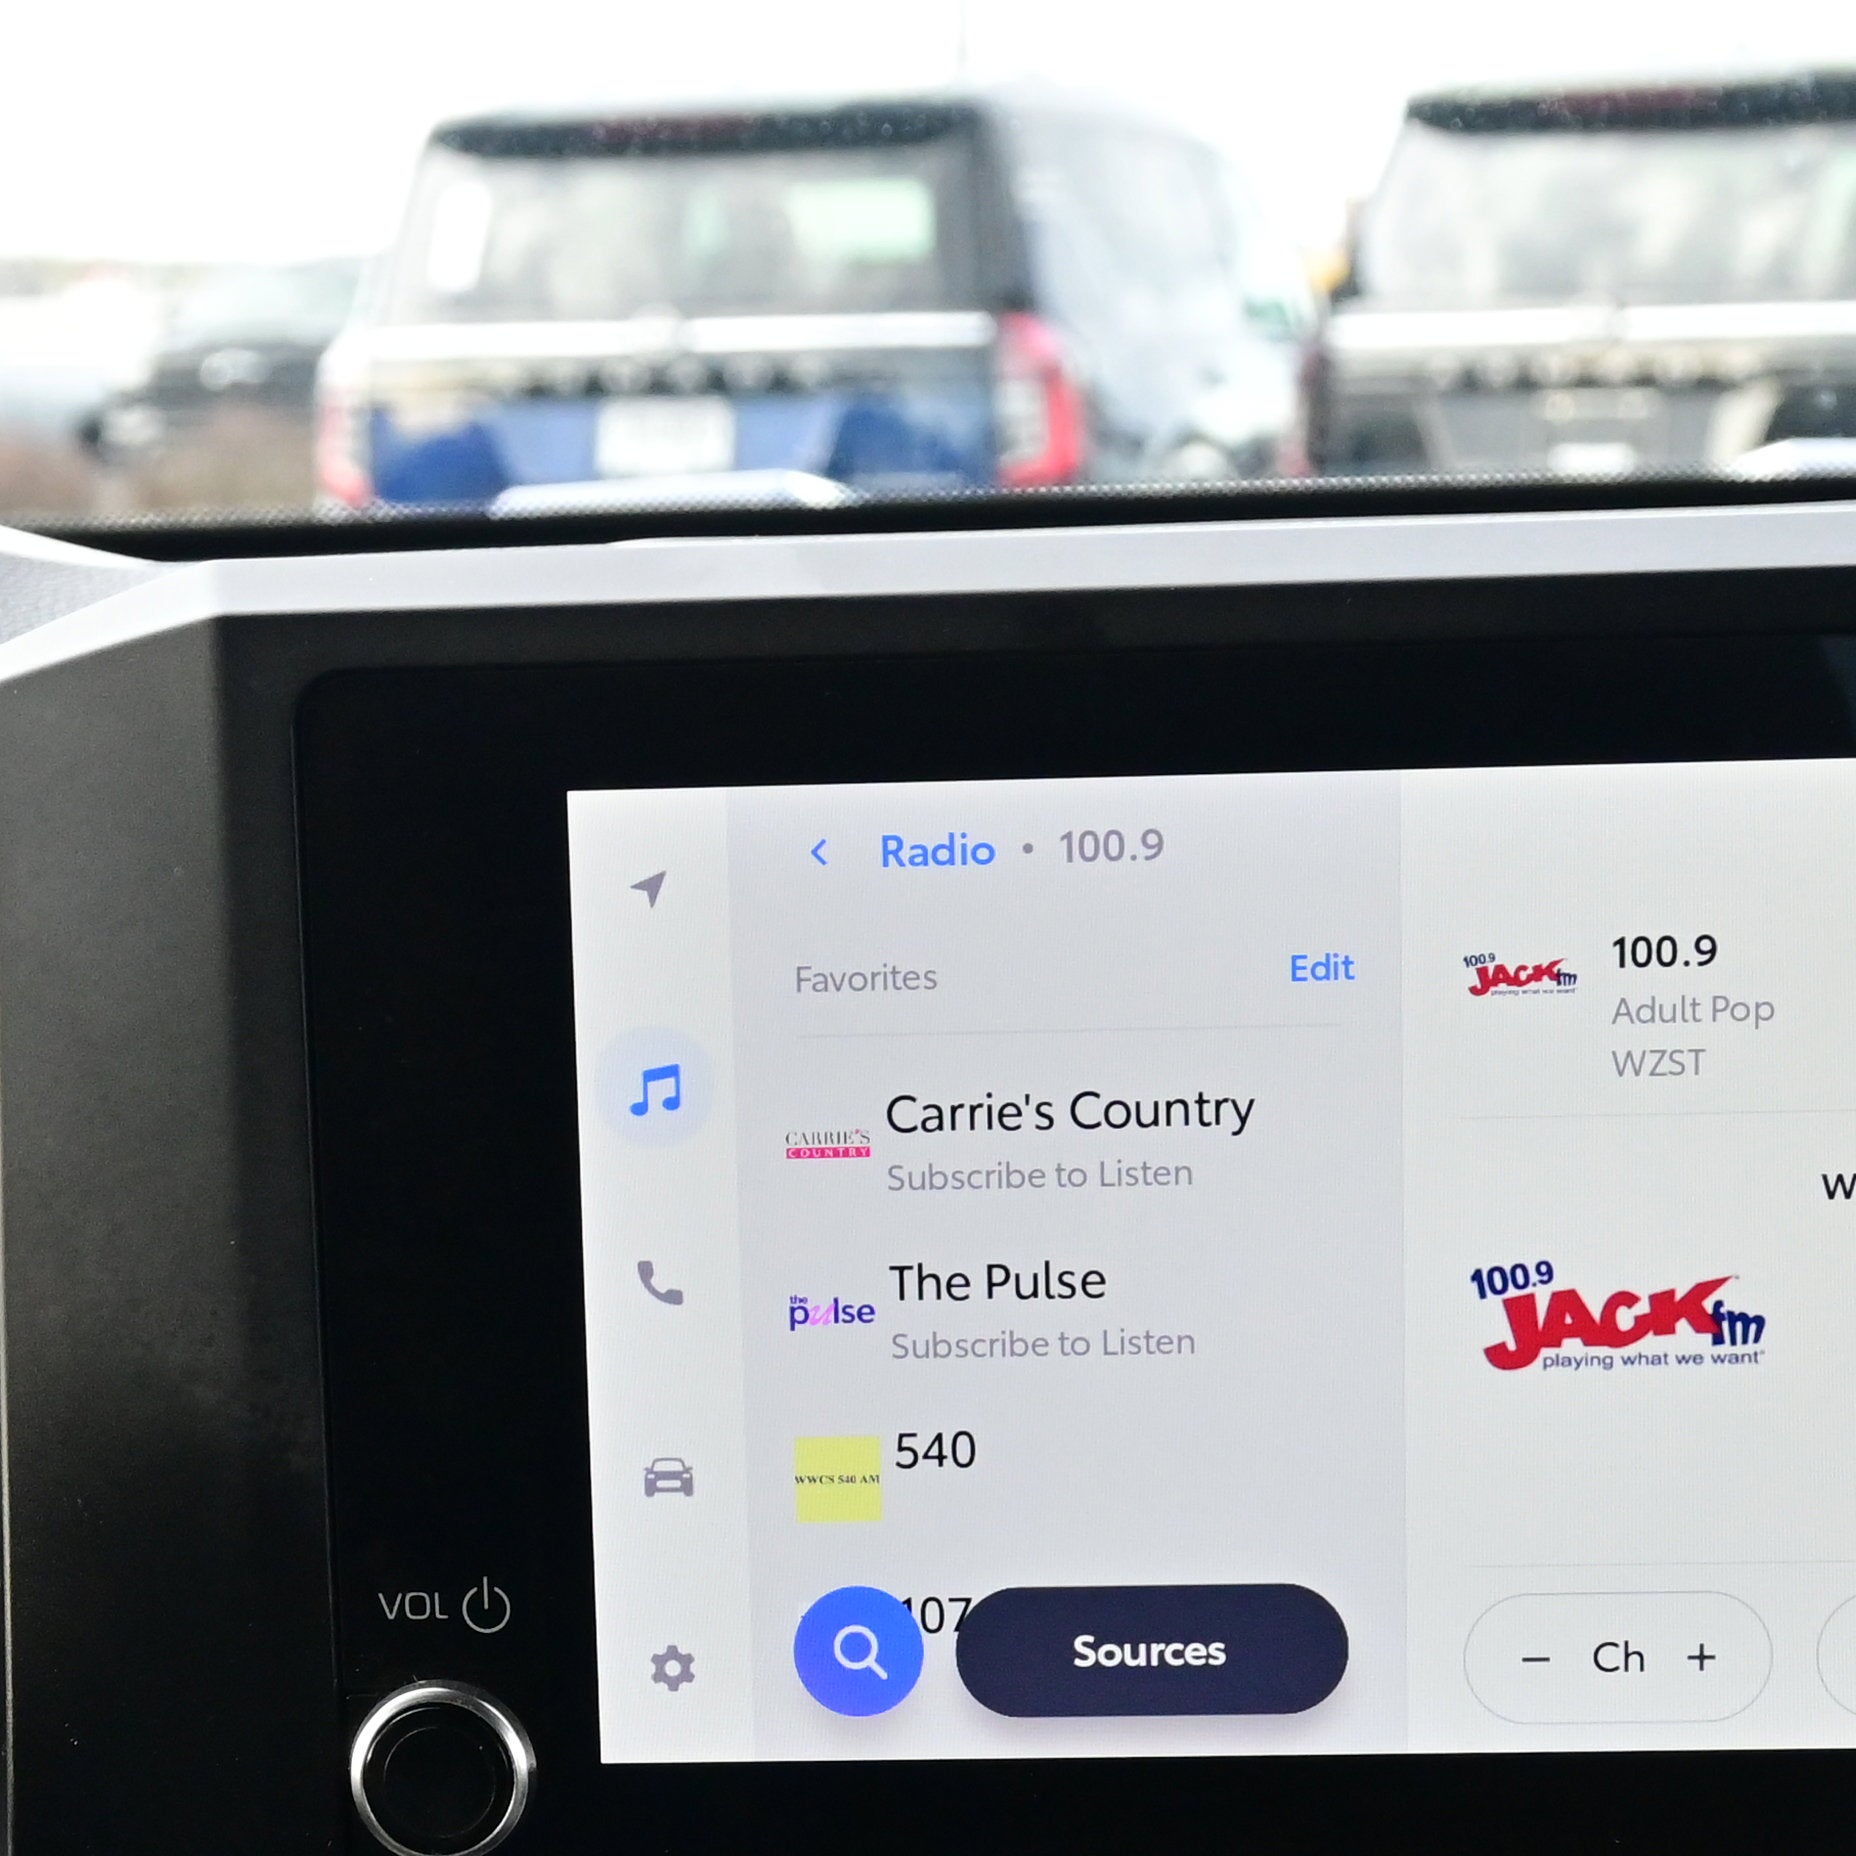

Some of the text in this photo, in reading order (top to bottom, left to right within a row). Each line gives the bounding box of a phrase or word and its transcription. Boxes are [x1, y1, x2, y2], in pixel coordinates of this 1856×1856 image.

[882, 829, 1164, 867] Radio 100.9
[1463, 953, 1496, 968] 100.9
[1613, 934, 1717, 968] 100.9
[796, 963, 937, 993] Favorites
[1291, 953, 1355, 982] Edit
[1468, 958, 1566, 996] JACK
[1612, 995, 1775, 1030] Adult Pop
[1612, 1049, 1706, 1077] WZST
[887, 1091, 1255, 1136] Carrie's Country
[788, 1148, 869, 1158] COUNTRY
[888, 1159, 1192, 1191] Subscribe to Listen
[889, 1260, 1106, 1301] The Pulse
[1470, 1260, 1555, 1300] 100.9
[790, 1297, 876, 1332] pulse
[1483, 1275, 1766, 1371] JACK fm
[892, 1328, 1195, 1359] Subscribe to Listen
[1543, 1351, 1759, 1370] playing what we want
[896, 1431, 975, 1469] 540
[378, 1592, 448, 1619] VOL
[1074, 1635, 1226, 1667] Sources
[1593, 1640, 1644, 1672] Ch
